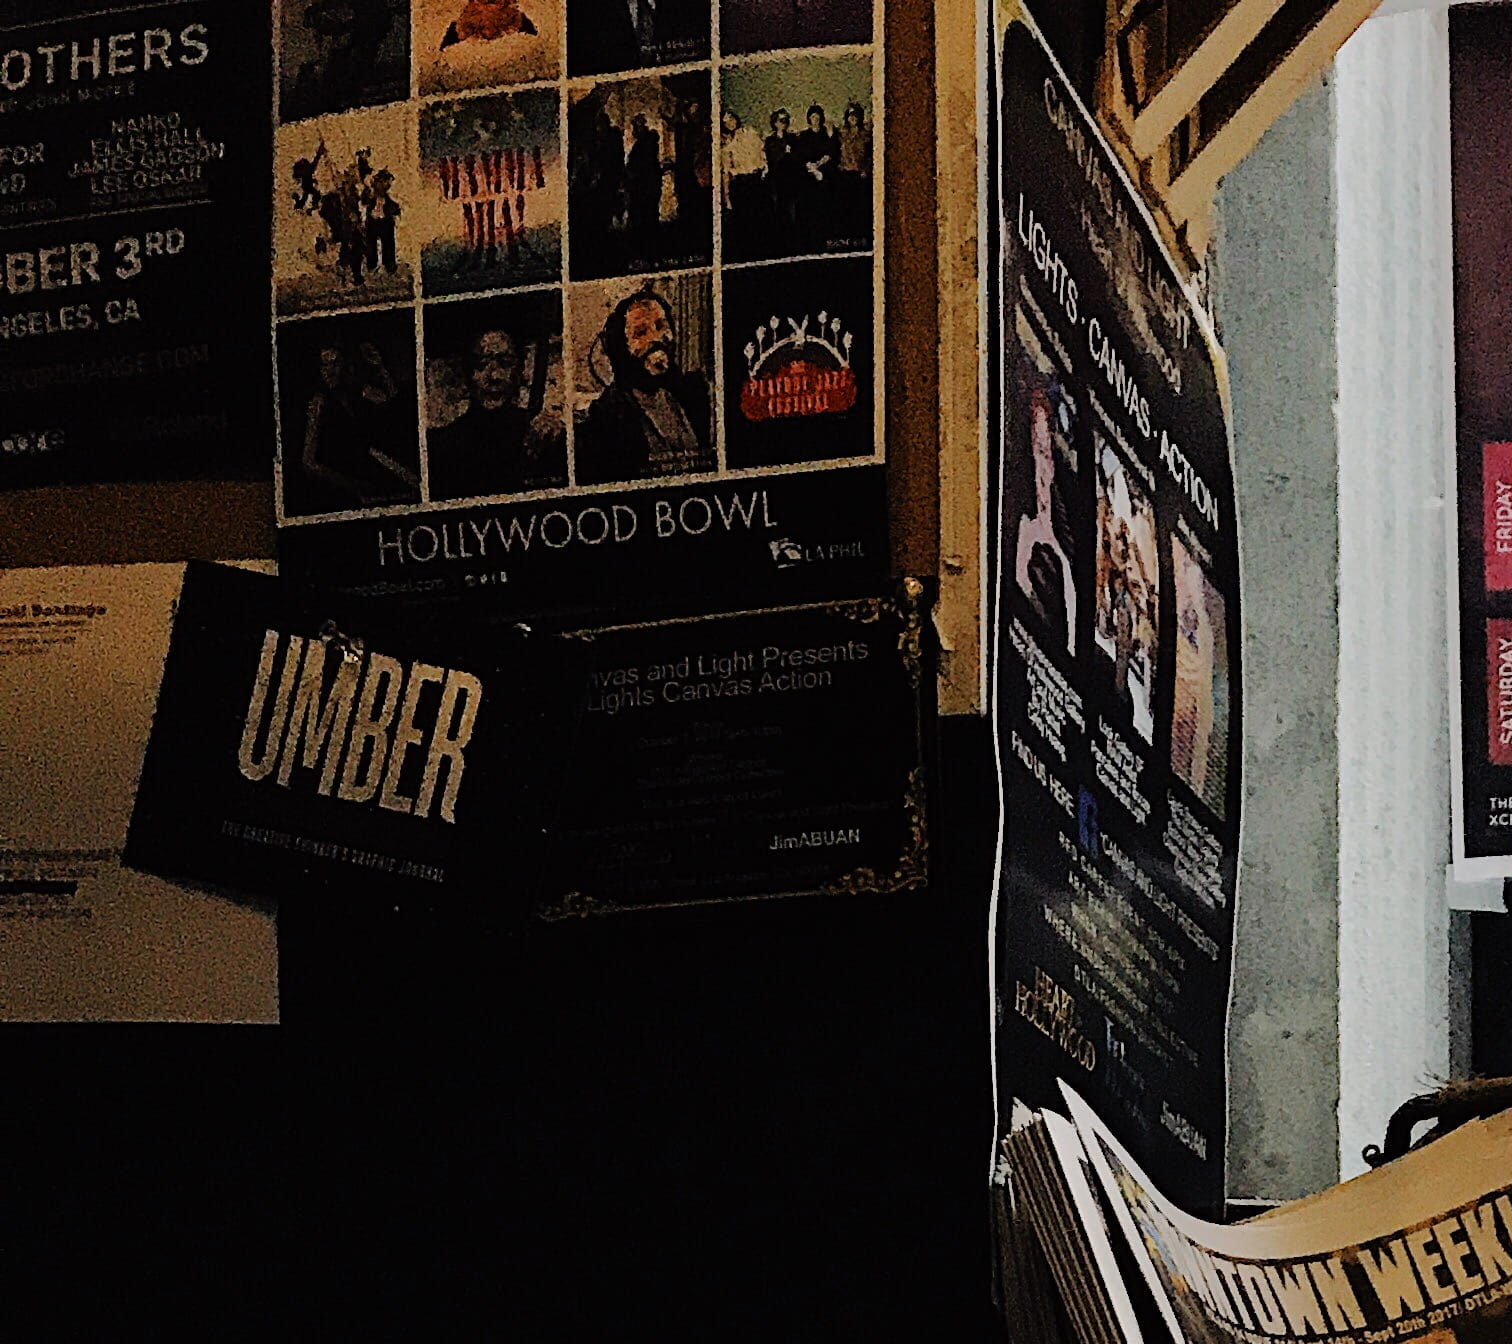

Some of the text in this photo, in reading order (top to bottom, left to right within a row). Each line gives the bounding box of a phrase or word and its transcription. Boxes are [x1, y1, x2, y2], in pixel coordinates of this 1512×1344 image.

[0, 240, 101, 295] BER
[104, 297, 144, 325] CA
[1018, 191, 1079, 325] LIGHTS
[1088, 317, 1151, 438] CANVAS
[1160, 428, 1220, 532] ACTION
[377, 489, 779, 567] HOLLYWOOD BOWL
[647, 655, 691, 681] and
[697, 649, 756, 679] Light
[761, 640, 870, 670] Presents
[662, 676, 753, 704] Canvas
[758, 668, 833, 694] Action
[237, 627, 483, 825] UMBER
